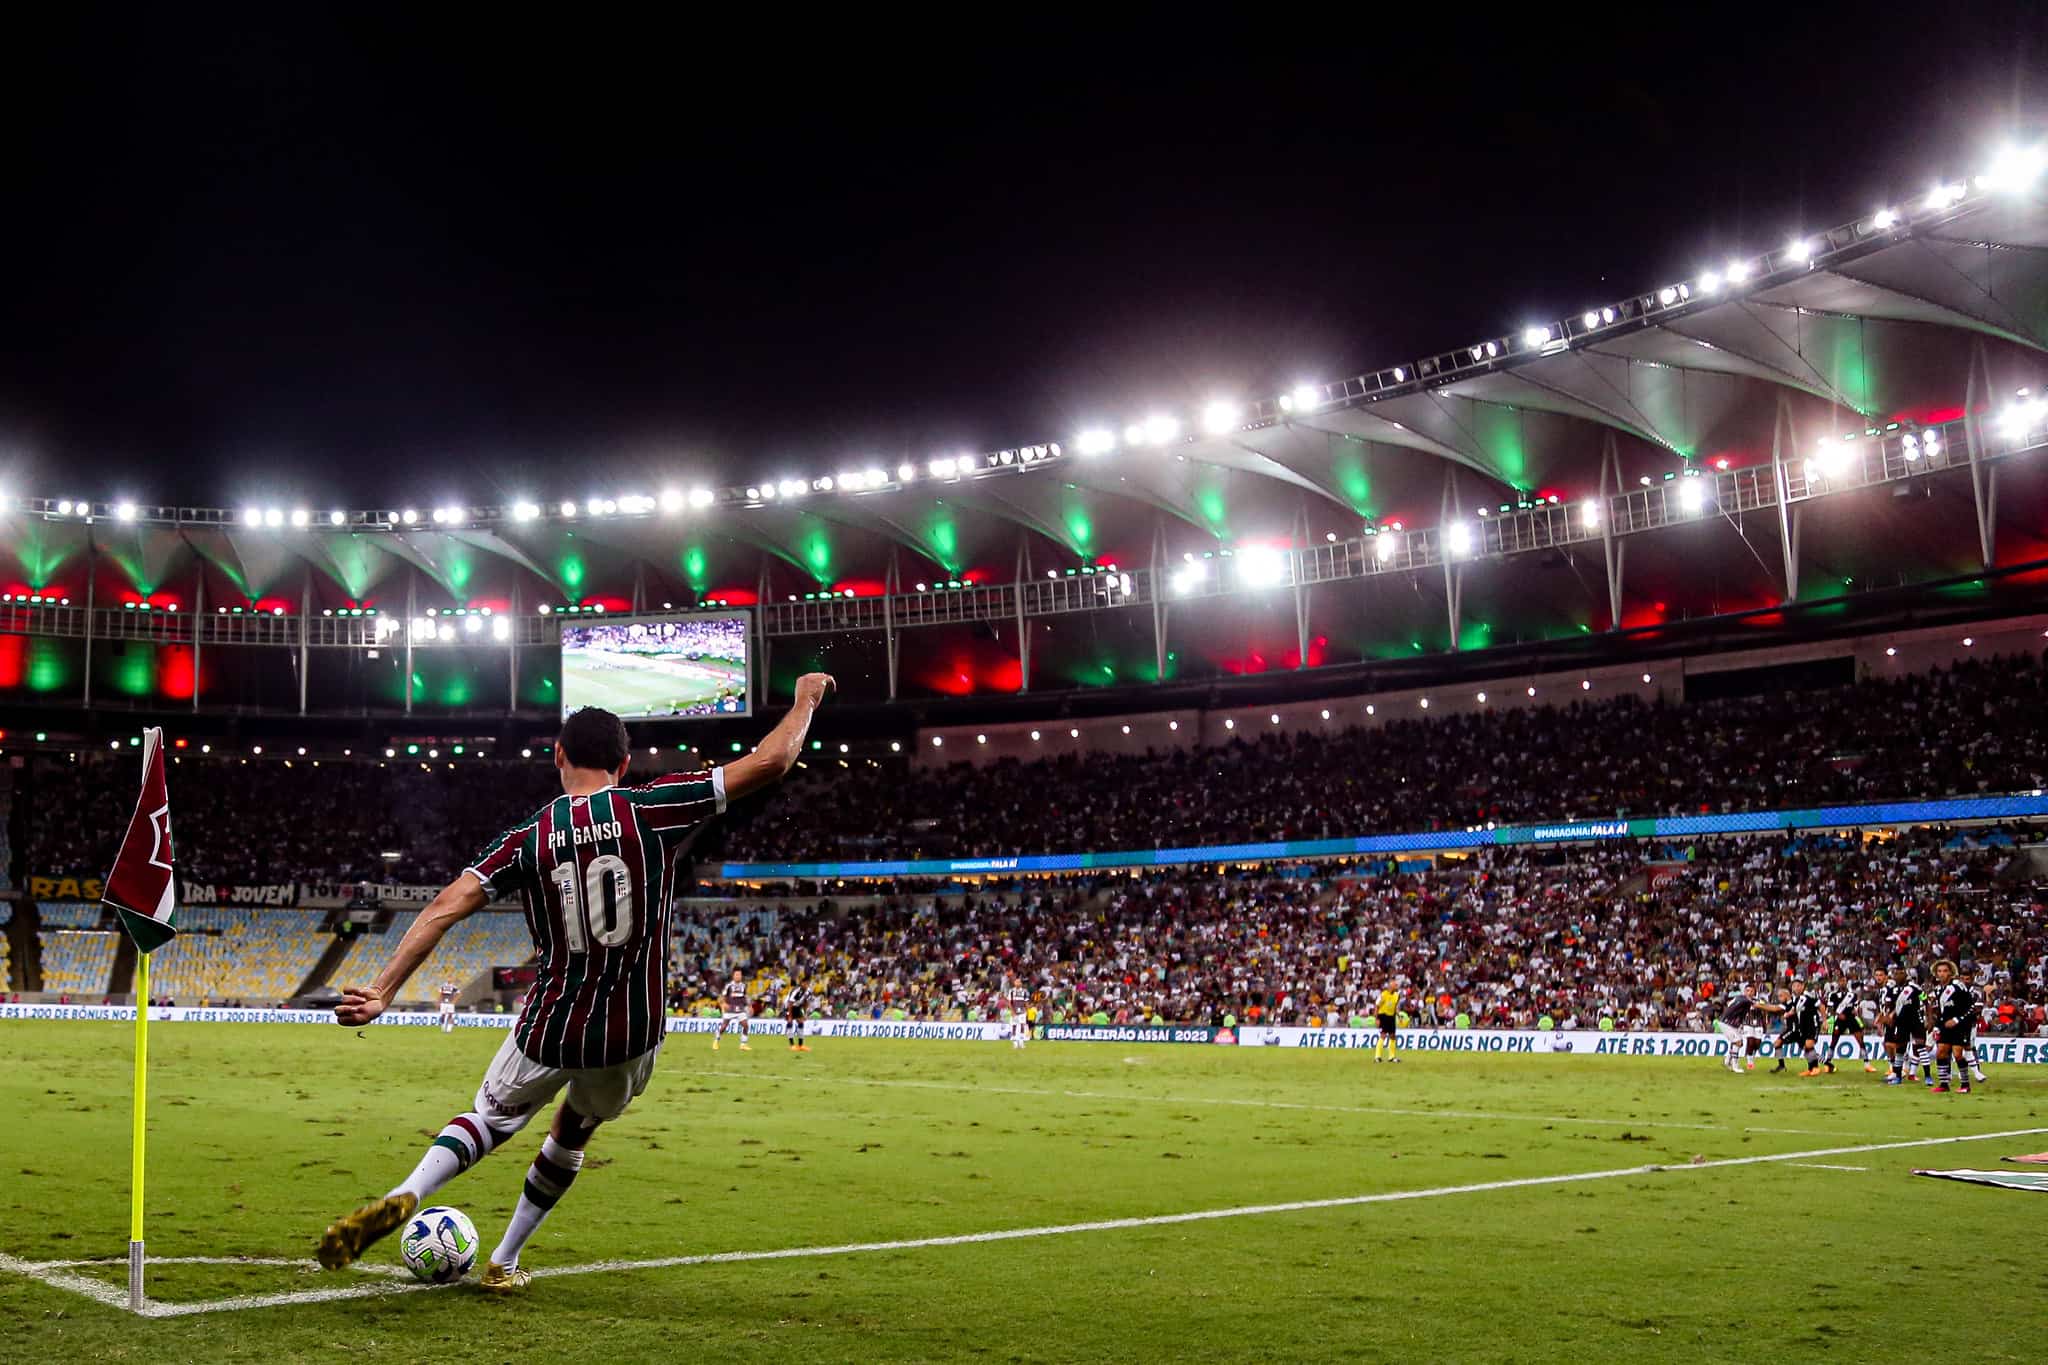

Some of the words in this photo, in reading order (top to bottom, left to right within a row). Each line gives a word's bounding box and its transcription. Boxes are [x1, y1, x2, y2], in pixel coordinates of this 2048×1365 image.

[548, 830, 566, 849] PH
[573, 821, 622, 845] GANSO
[617, 870, 625, 886] TIM
[231, 883, 295, 905] JOVEM
[563, 880, 572, 895] TIM
[551, 854, 634, 954] 10
[24, 1008, 52, 1019] 1.200
[55, 1009, 70, 1019] DE
[72, 1006, 109, 1020] BÔNUS
[112, 1011, 128, 1021] NO
[219, 1012, 244, 1022] 1.200
[247, 1012, 260, 1022] DE
[262, 1009, 296, 1023] BÔNUS
[300, 1014, 313, 1024] NO
[316, 1014, 331, 1024] PIX
[402, 1015, 428, 1026] 1.200
[482, 1017, 496, 1027] NO
[737, 1022, 767, 1034] BNUS
[769, 1023, 783, 1034] NO
[831, 1022, 849, 1037] ATÉ
[851, 1024, 863, 1037] R$
[865, 1025, 891, 1038] 1.200
[893, 1025, 906, 1038] DE
[909, 1022, 944, 1039] BÔNUS
[947, 1026, 963, 1040] NO
[965, 1027, 984, 1040] PIX
[1048, 1027, 1135, 1041] BRASILEIRÃO
[1137, 1028, 1169, 1041] ASSAÍ
[1175, 1030, 1208, 1042] 2023
[1299, 1027, 1326, 1048] ATÉ
[1328, 1032, 1346, 1048] R$
[1396, 1035, 1414, 1049] DE
[1418, 1031, 1473, 1050] BÔNUS
[1477, 1036, 1503, 1051] NO
[1507, 1037, 1535, 1053] PIX
[1595, 1033, 1628, 1054] ATÉ
[1631, 1036, 1655, 1055] R$
[1660, 1038, 1710, 1056] 1.200
[1978, 1039, 2017, 1063] ATÉ
